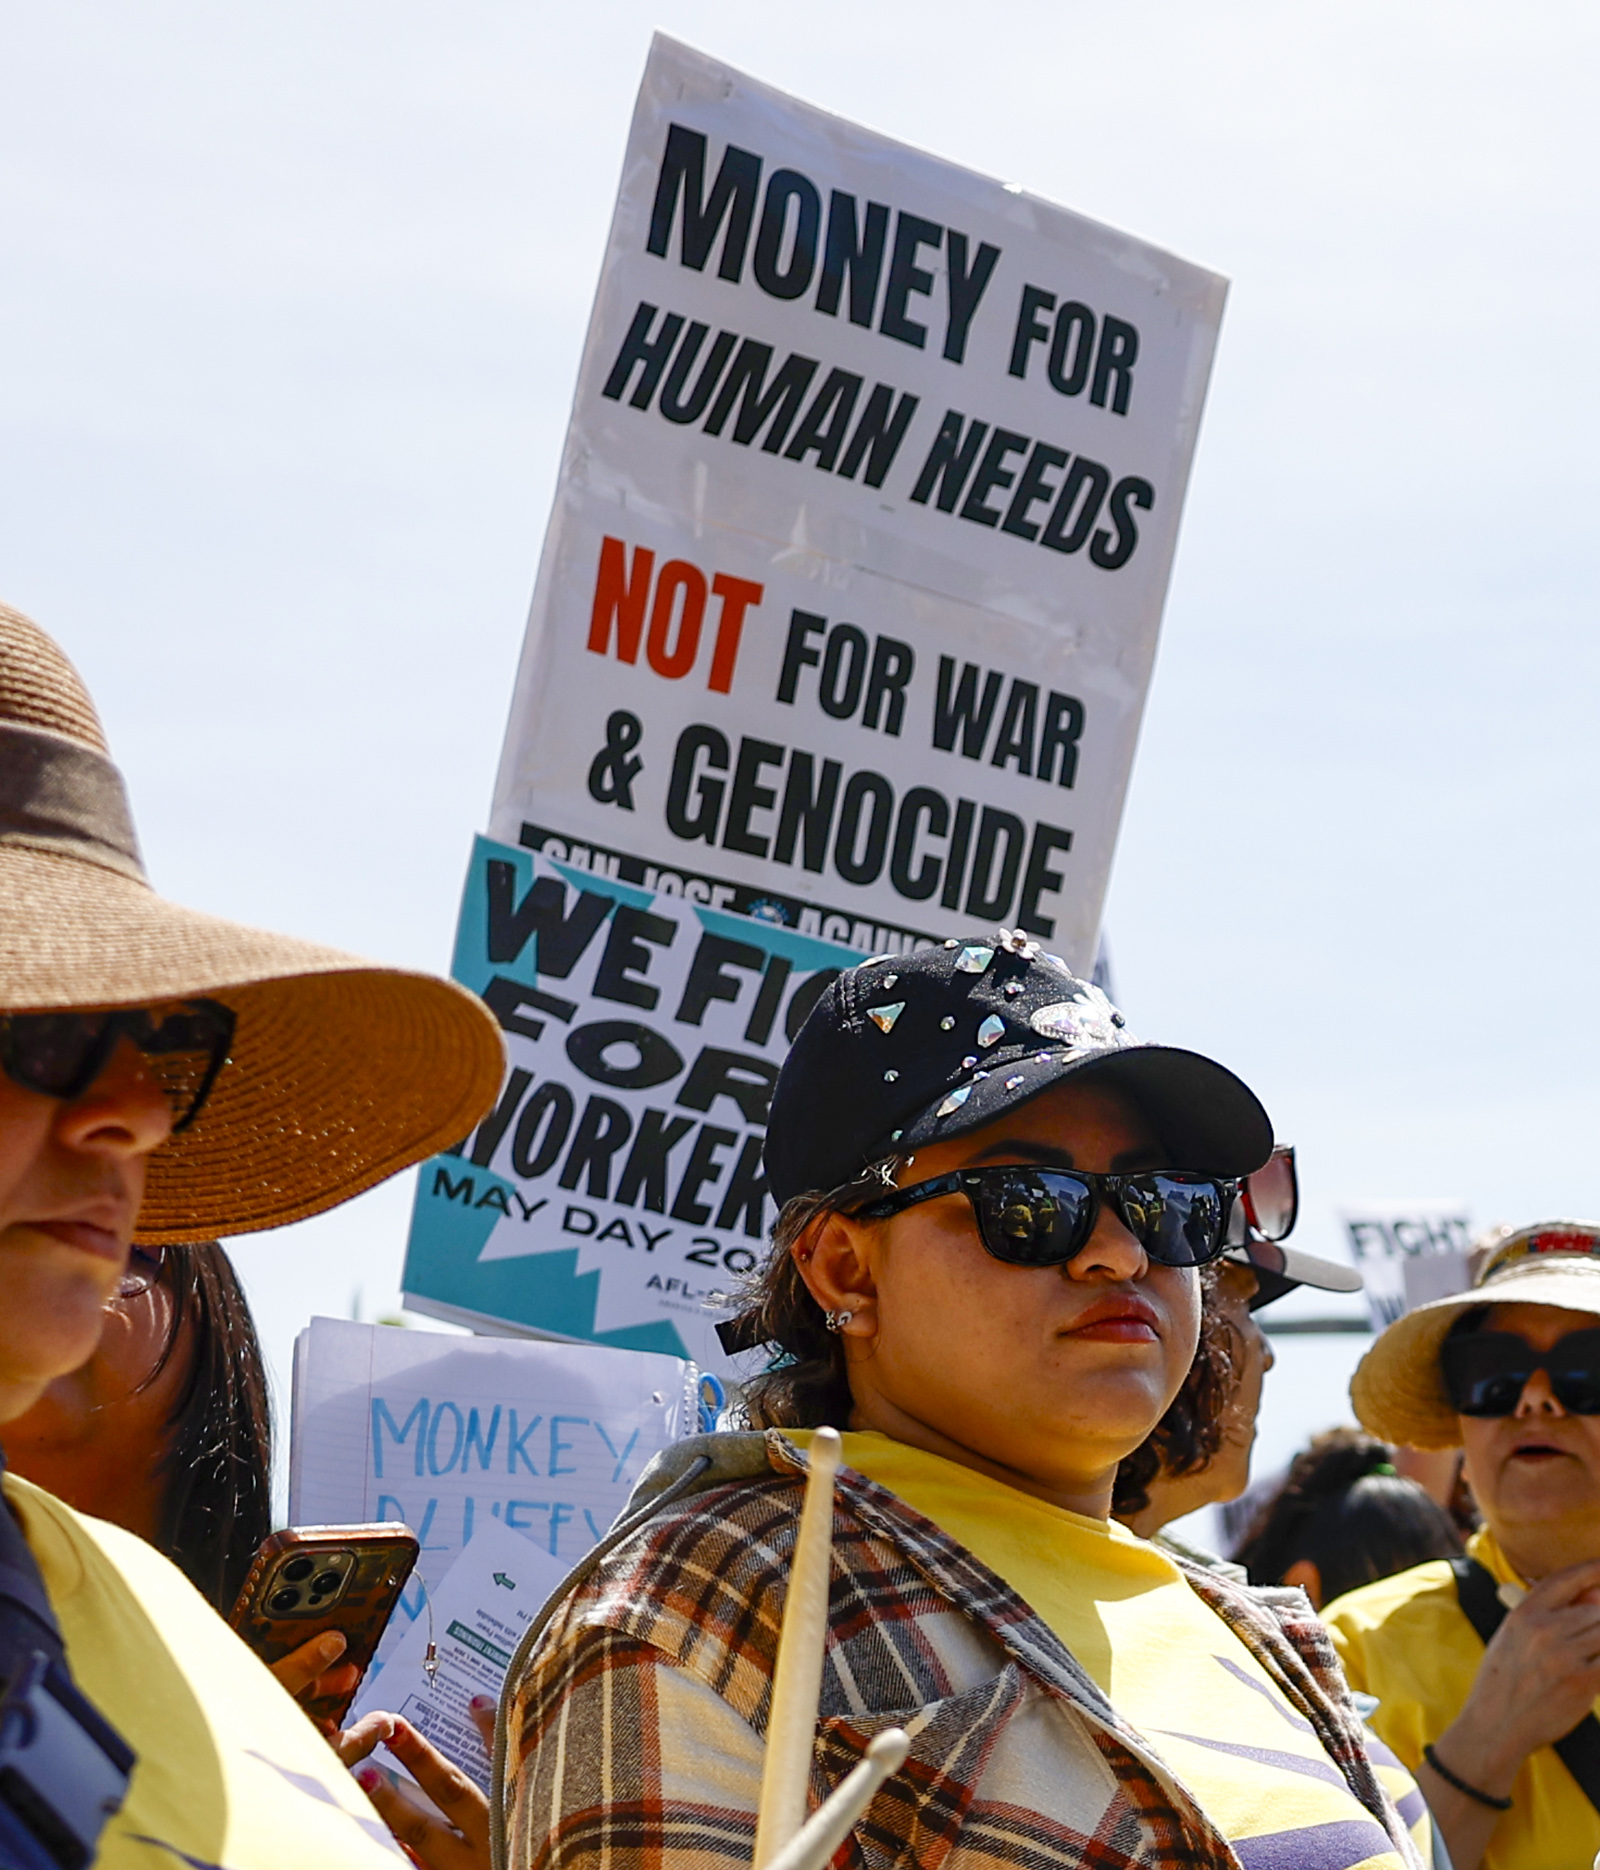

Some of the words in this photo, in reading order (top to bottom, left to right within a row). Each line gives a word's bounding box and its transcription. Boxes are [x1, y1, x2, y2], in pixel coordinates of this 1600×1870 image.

[645, 123, 1002, 366] MONEY
[1007, 283, 1140, 416] FOR
[602, 302, 920, 490] HUMAN
[908, 410, 1156, 571] NEEDS
[587, 536, 764, 695] NOT
[776, 608, 916, 738] FOR
[931, 655, 1086, 789] WAR
[486, 858, 678, 1010] WE
[588, 709, 645, 812] &
[665, 723, 1074, 941] GENOCIDE
[433, 1168, 548, 1222] MAY
[561, 1206, 673, 1252] DAY
